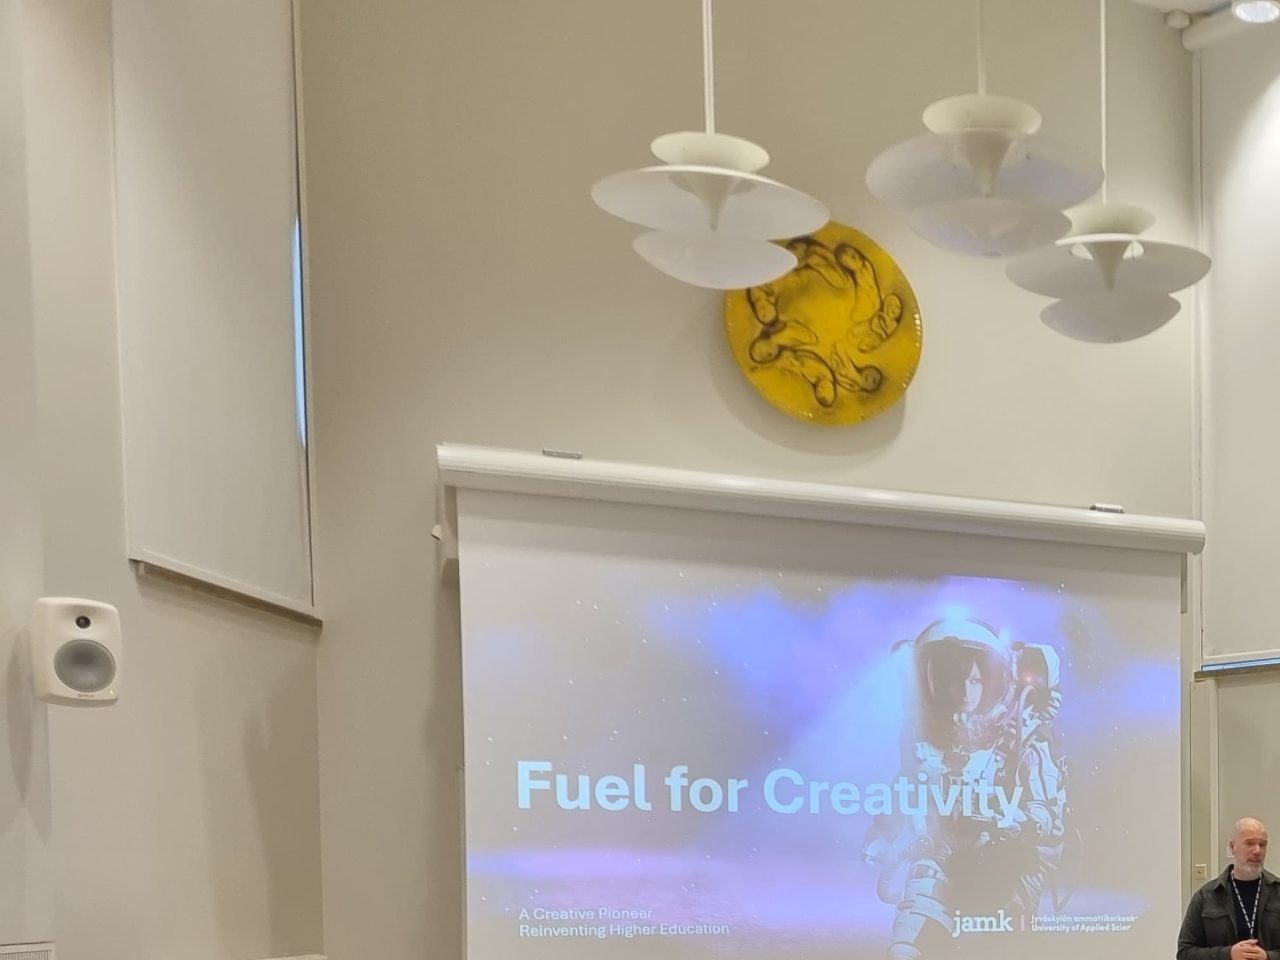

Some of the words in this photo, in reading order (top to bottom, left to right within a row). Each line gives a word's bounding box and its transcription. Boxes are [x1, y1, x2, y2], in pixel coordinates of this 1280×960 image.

[516, 760, 652, 812] Fuel
[665, 765, 748, 813] for
[763, 768, 1024, 829] Creativity
[518, 908, 529, 920] A
[533, 907, 594, 920] Creative
[599, 907, 653, 920] Pioneer
[519, 924, 606, 938] Reinventing
[609, 923, 654, 938] Higher
[660, 922, 730, 935] Education
[952, 909, 1014, 938] jamk
[1031, 923, 1070, 933] University
